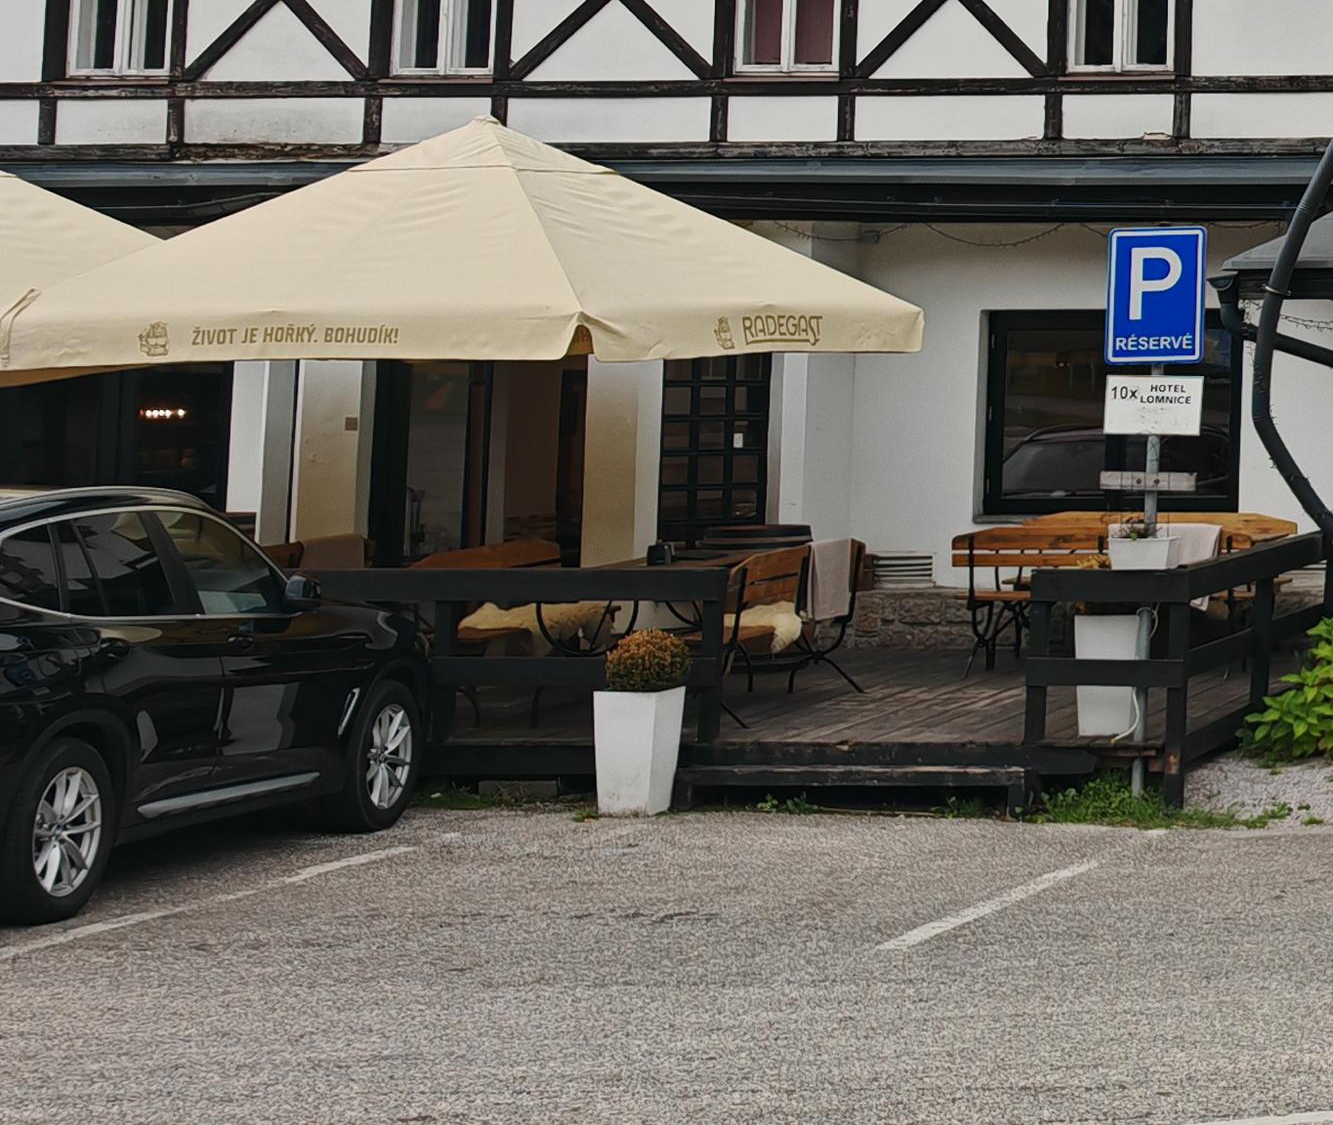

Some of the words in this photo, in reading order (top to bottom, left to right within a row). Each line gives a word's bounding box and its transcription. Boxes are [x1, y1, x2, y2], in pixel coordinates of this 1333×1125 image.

[1129, 247, 1183, 321] P
[191, 326, 238, 346] ŽIVOT
[240, 327, 258, 344] JE
[262, 323, 318, 344] HOŘKÝ.
[323, 325, 399, 344] BOHUDÍK!
[742, 315, 823, 345] RADEGAST
[1115, 333, 1193, 351] RÉSERVÉ
[1111, 386, 1138, 400] 10x
[1149, 384, 1187, 393] HOTEL
[1139, 395, 1192, 405] LOMNICE
